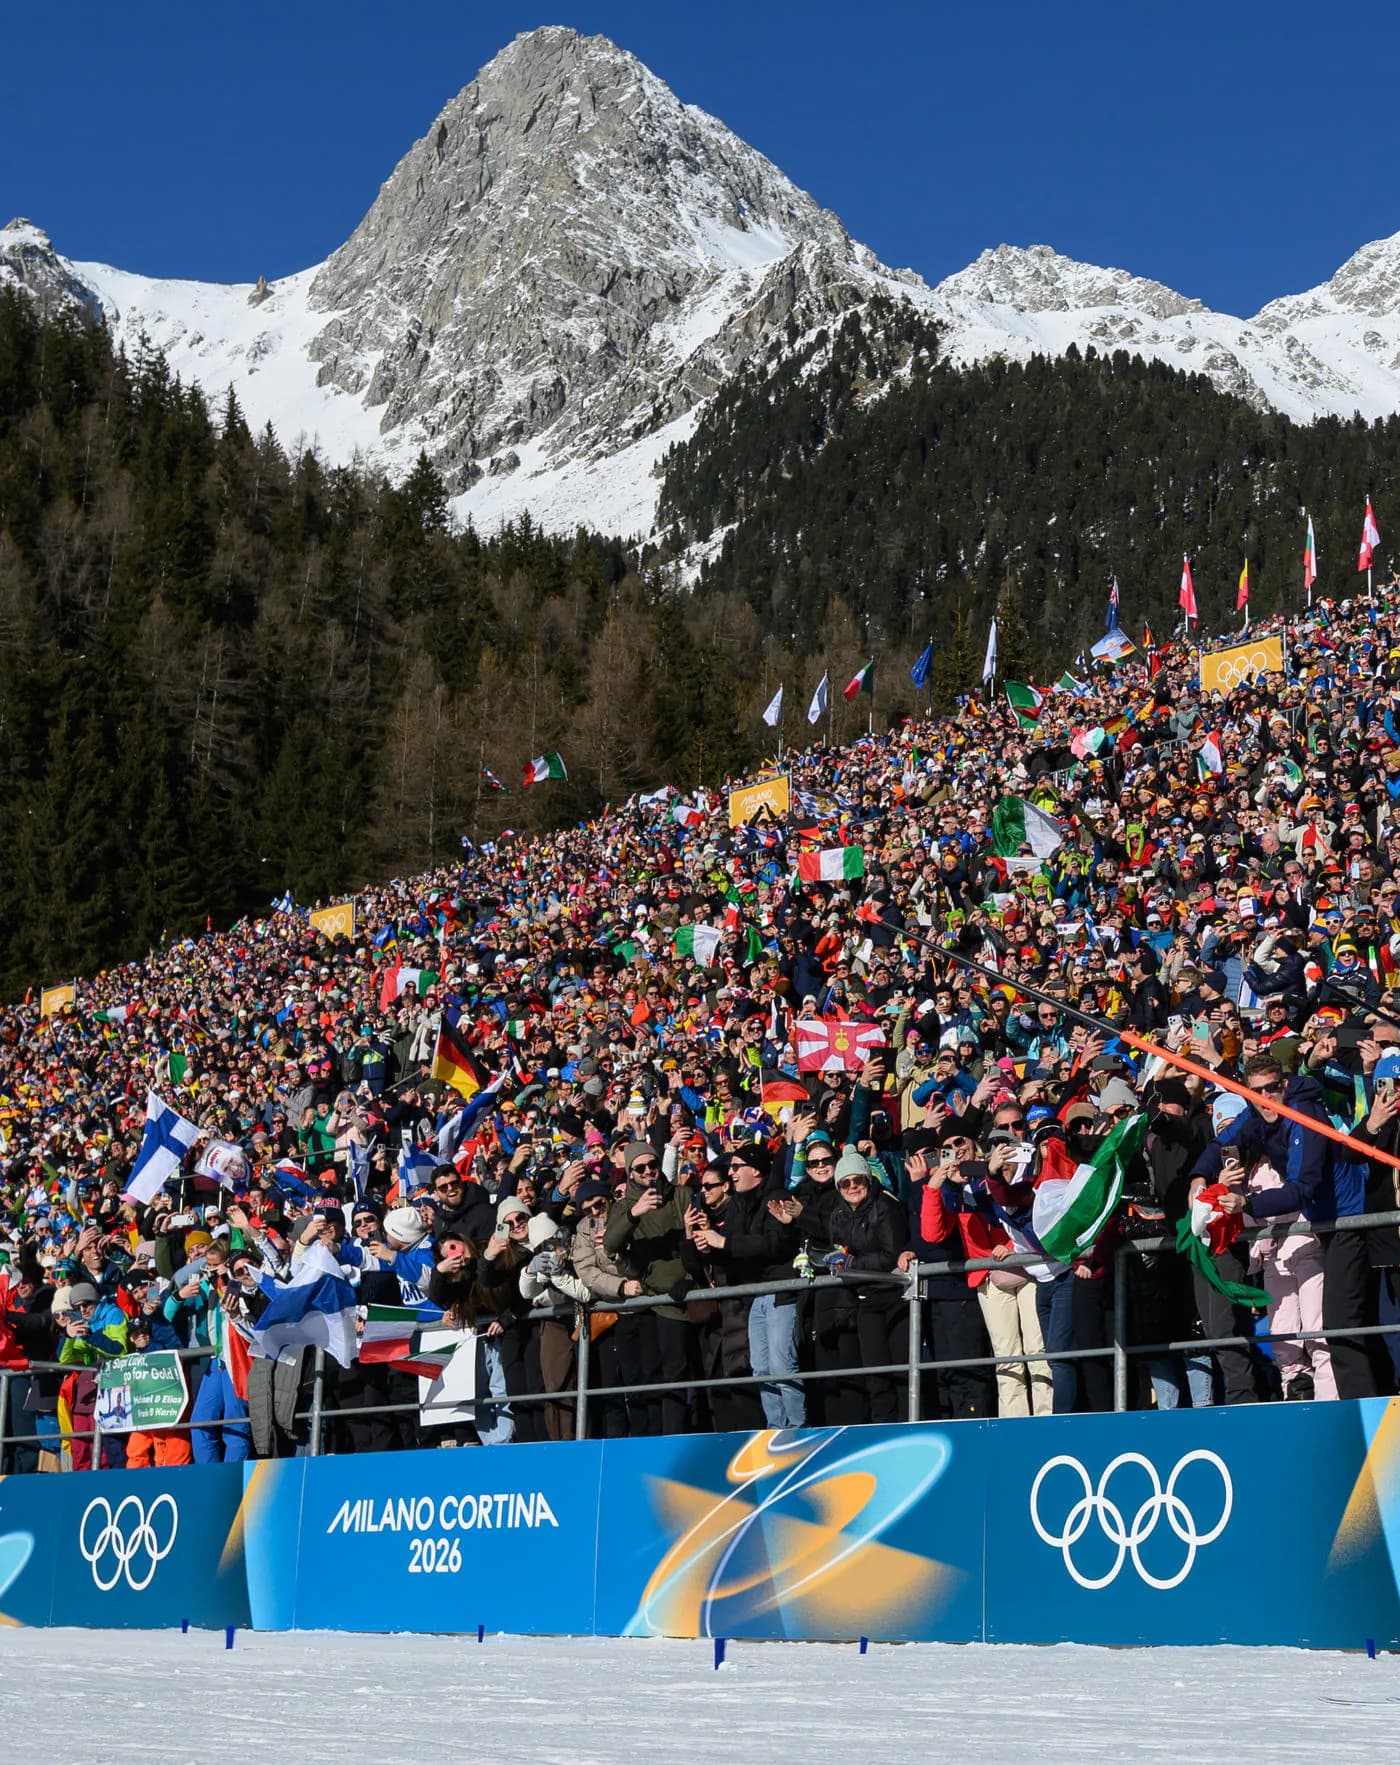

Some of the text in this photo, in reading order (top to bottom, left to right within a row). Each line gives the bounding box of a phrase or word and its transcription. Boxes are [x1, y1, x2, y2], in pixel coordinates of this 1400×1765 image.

[155, 1407, 178, 1416] Karin
[327, 1492, 559, 1534] MILANO CORTINA
[408, 1538, 462, 1573] 2026
